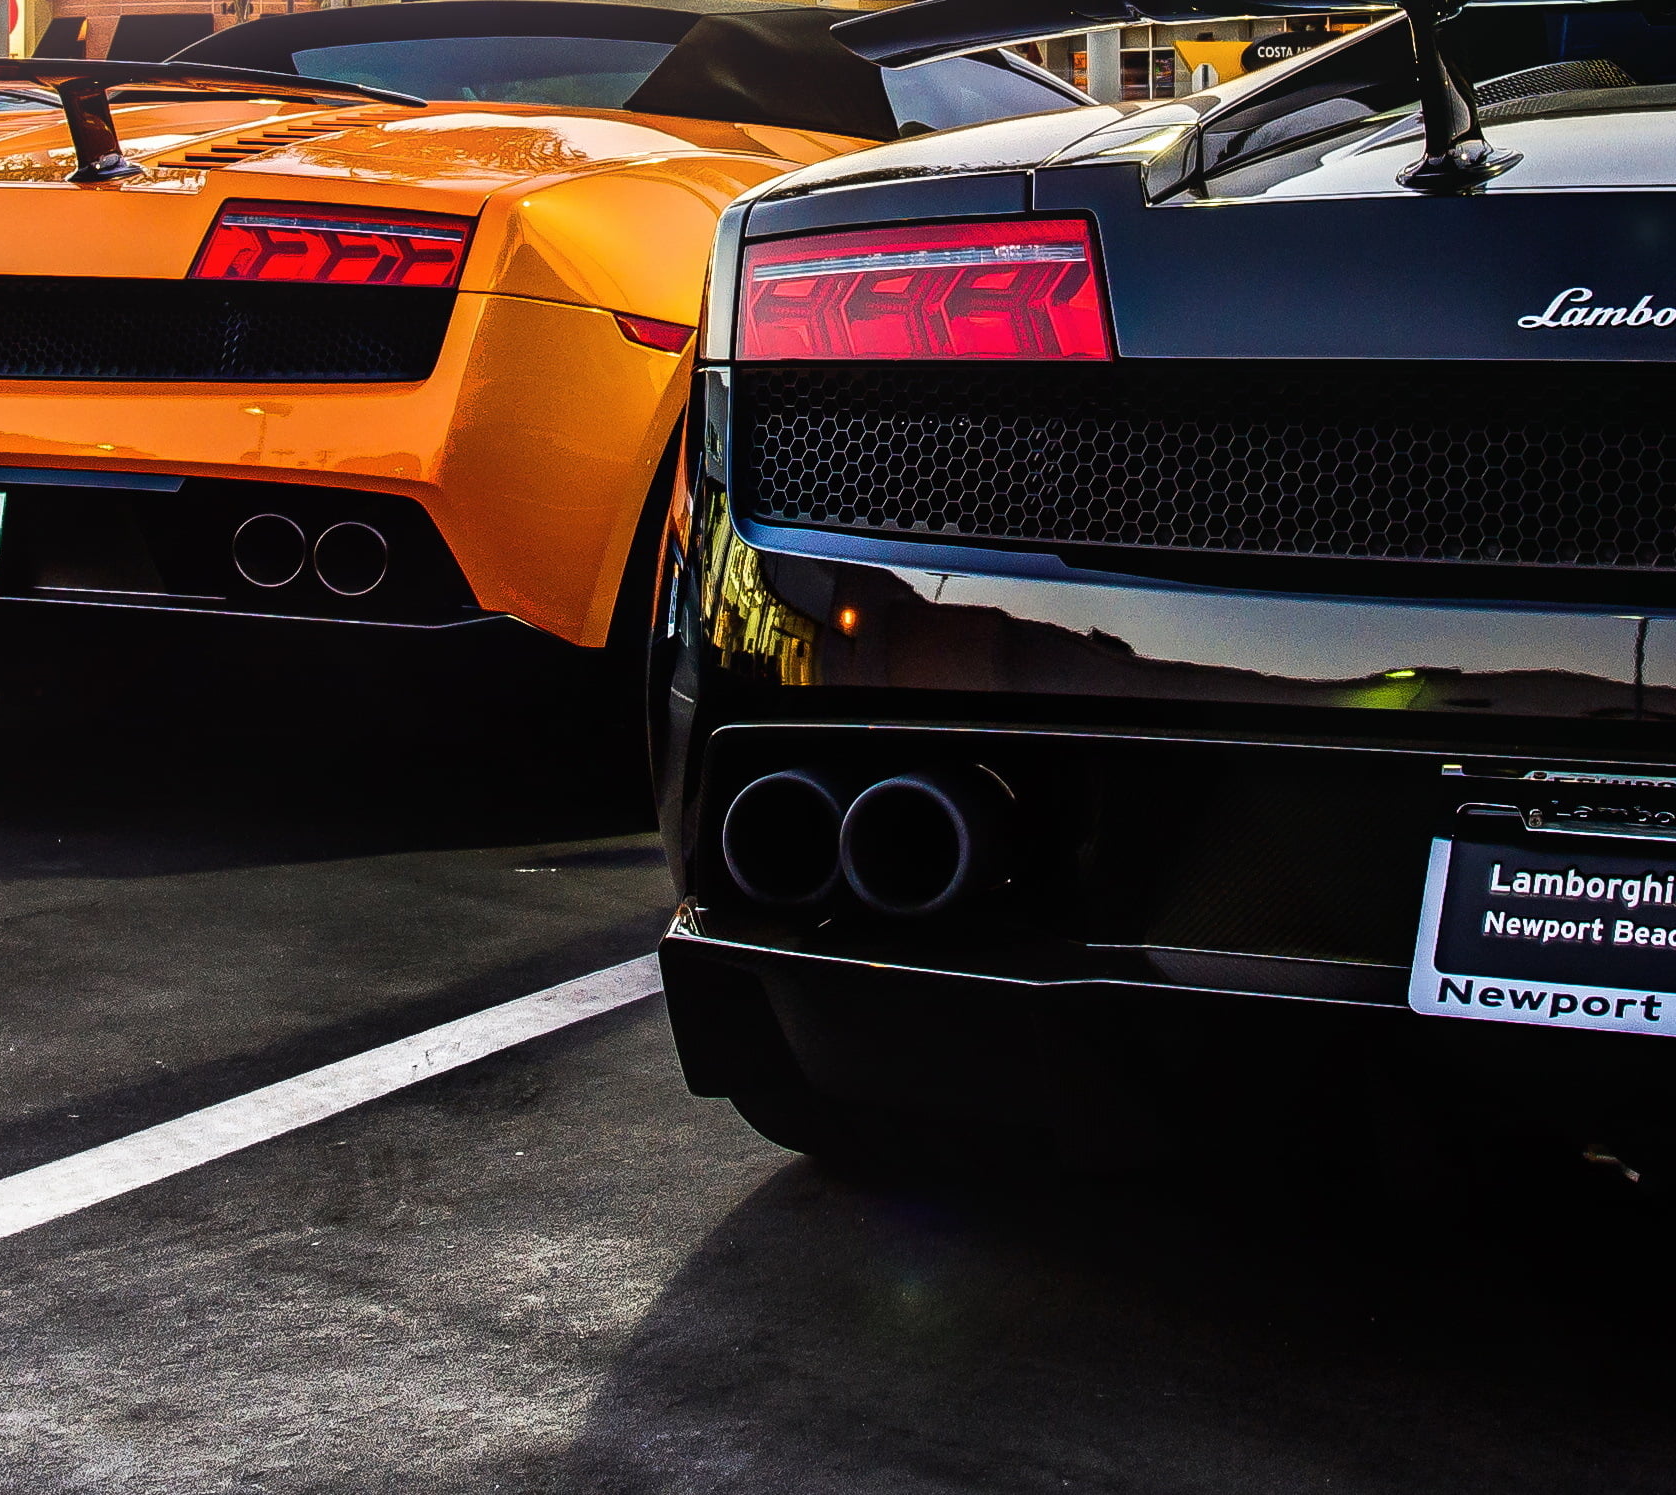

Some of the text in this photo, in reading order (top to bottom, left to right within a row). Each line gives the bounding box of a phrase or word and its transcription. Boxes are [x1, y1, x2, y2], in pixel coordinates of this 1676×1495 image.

[1257, 46, 1293, 58] COSTA
[1483, 911, 1604, 943] Newport
[1436, 977, 1662, 1019] Newport
